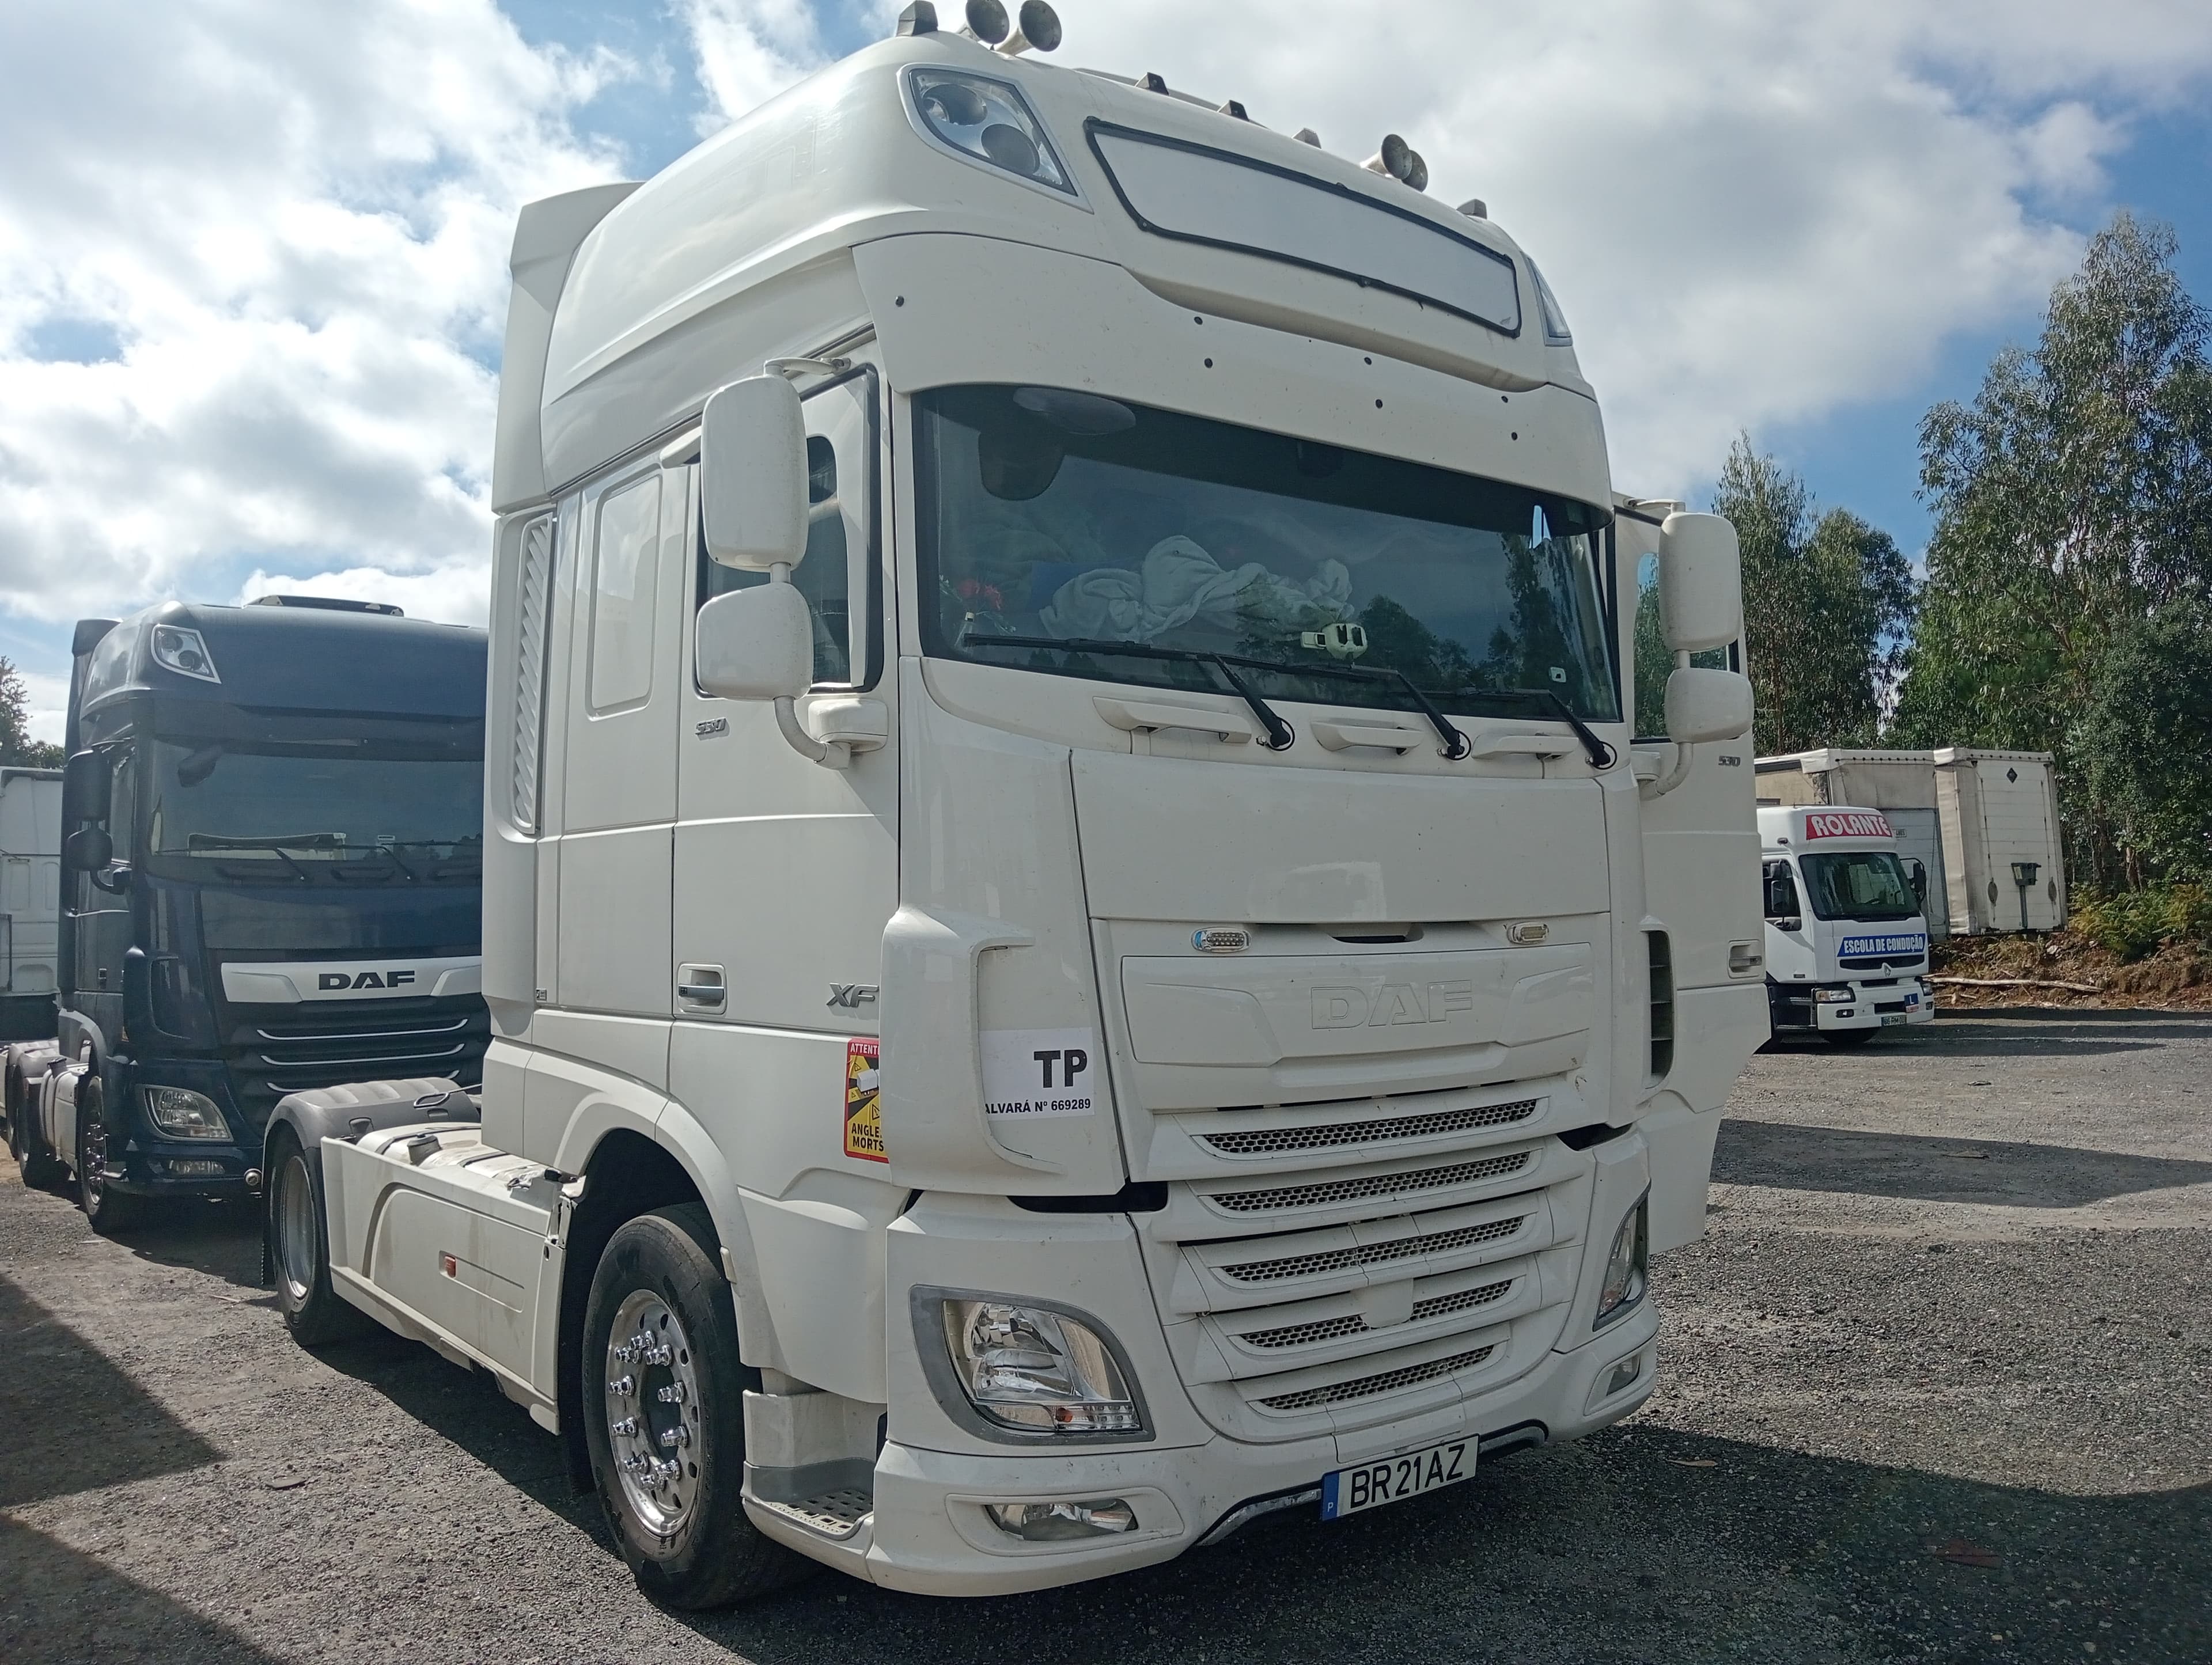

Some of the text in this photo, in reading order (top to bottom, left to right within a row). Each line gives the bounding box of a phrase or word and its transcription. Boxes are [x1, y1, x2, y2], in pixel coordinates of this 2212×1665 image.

[1811, 815, 1891, 836] ROLANTE
[1844, 935, 1923, 954] ESCOLA DE CONDUÇÃO
[319, 970, 415, 990] DAF
[827, 983, 878, 1008] XF
[1310, 980, 1472, 1030] DAF
[1909, 995, 1915, 1004] L
[1034, 1049, 1088, 1088] TP
[1051, 1098, 1090, 1111] 669289
[851, 1122, 882, 1138] ANGLE
[853, 1136, 884, 1152] MORTS
[1327, 1502, 1334, 1513] P
